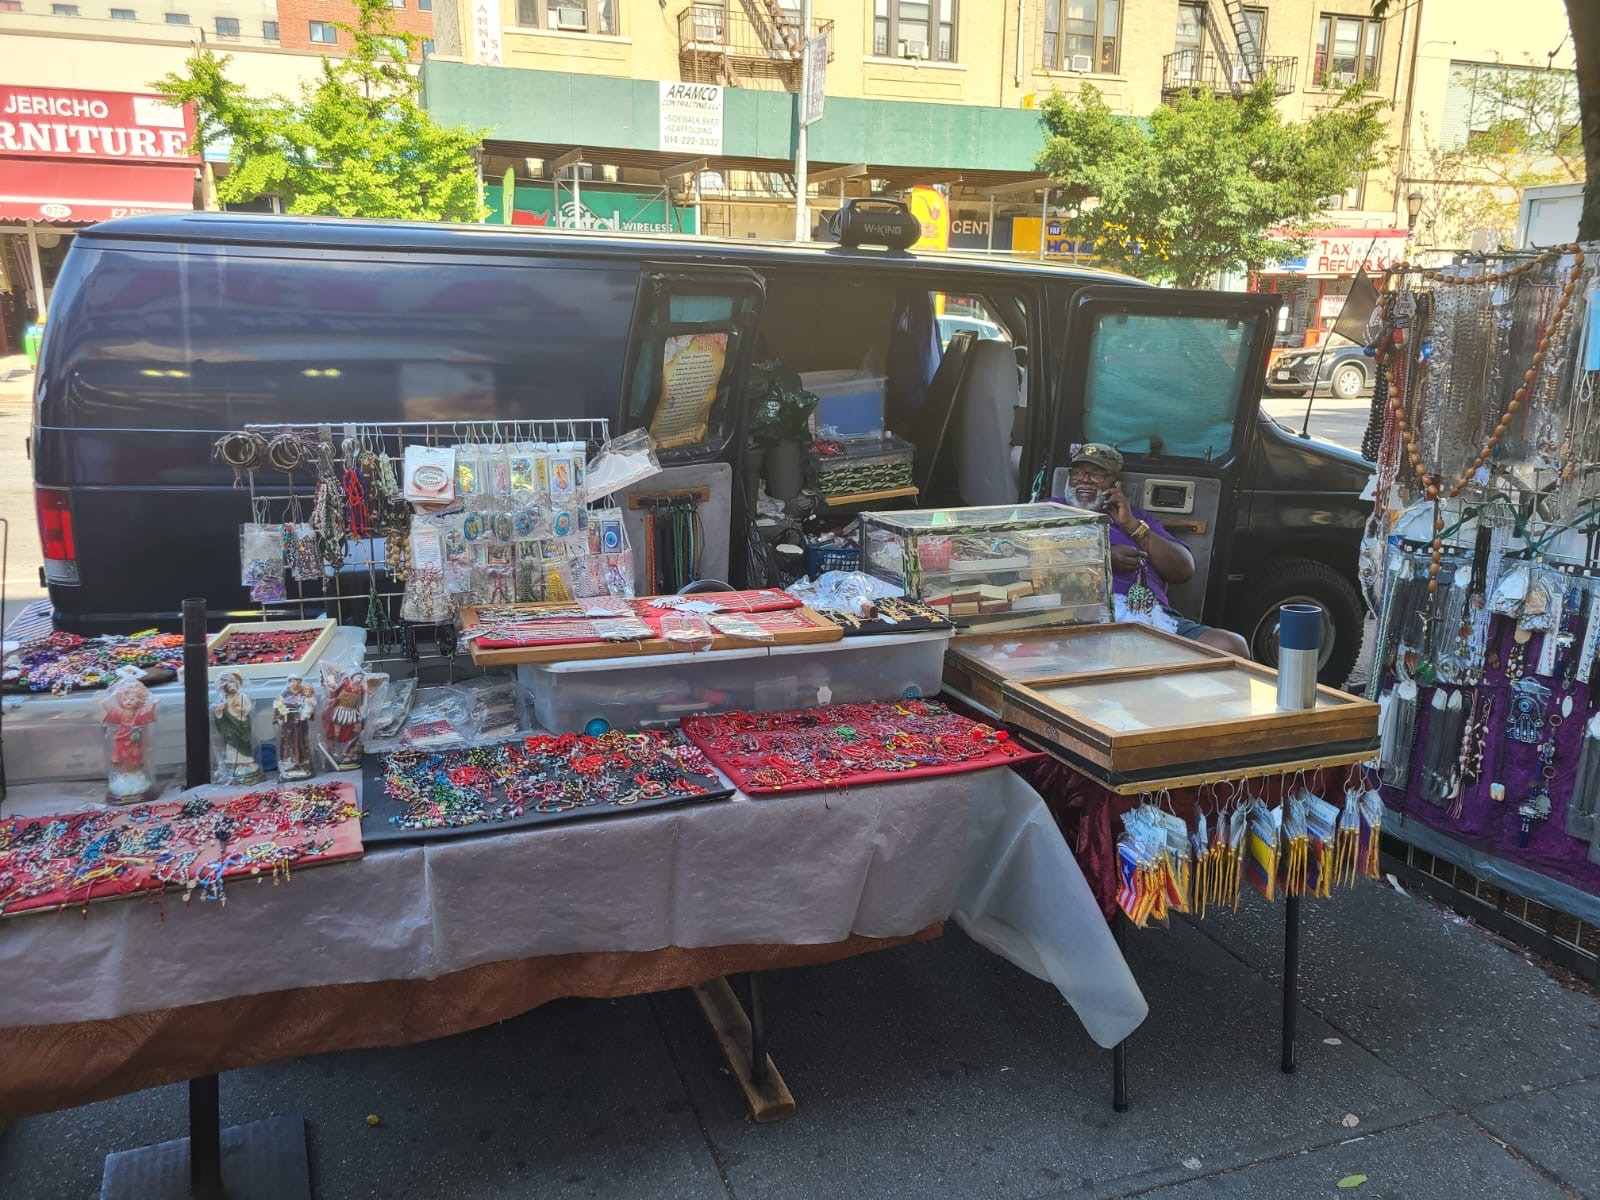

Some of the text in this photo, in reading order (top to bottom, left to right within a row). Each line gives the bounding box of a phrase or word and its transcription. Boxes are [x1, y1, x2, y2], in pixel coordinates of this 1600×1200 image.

[666, 84, 718, 101] ARAMCO
[4, 95, 109, 119] JERICHO
[662, 99, 708, 109] CONTRACTING
[0, 119, 189, 159] RNITURE
[622, 221, 673, 233] WIRELESS
[951, 219, 990, 236] CENT
[1320, 240, 1350, 256] TAX
